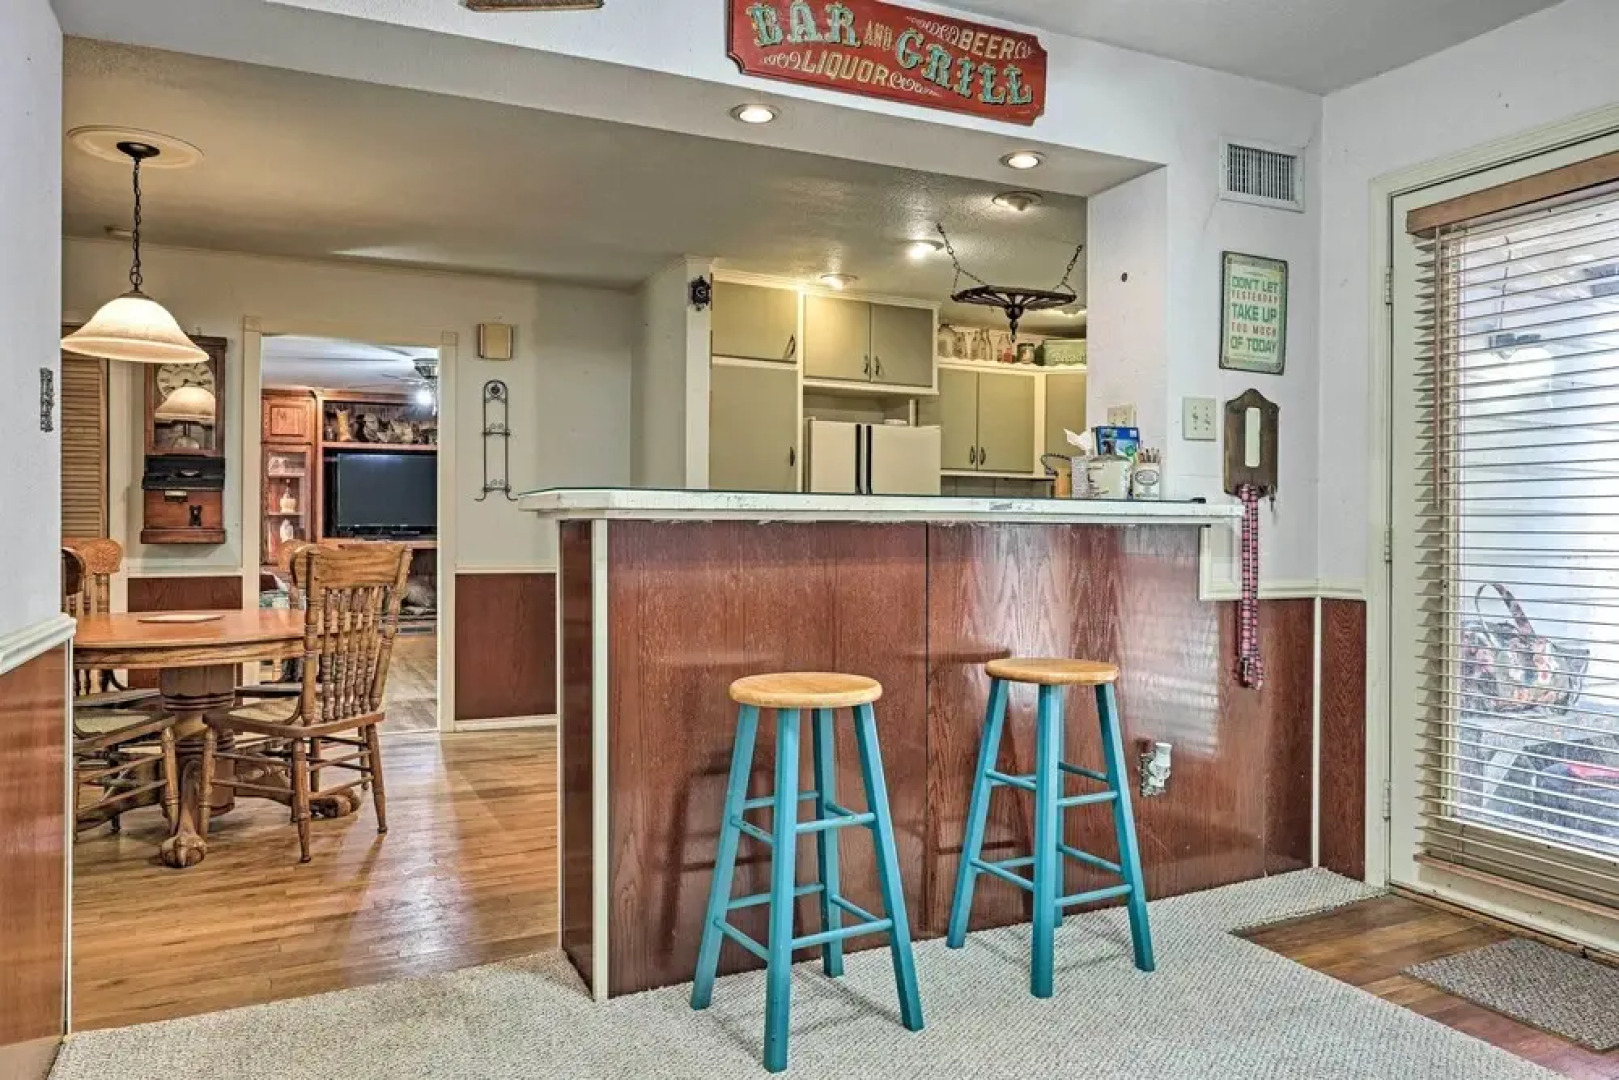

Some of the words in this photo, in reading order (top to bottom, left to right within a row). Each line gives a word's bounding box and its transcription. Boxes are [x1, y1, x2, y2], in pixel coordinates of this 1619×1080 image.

[746, 0, 861, 47] BAR
[864, 20, 893, 51] AND
[896, 27, 1034, 105] GRILL
[958, 28, 1016, 60] BEER
[801, 49, 890, 87] LIQUOR
[1262, 281, 1278, 293] LET
[1231, 303, 1259, 321] TAKE
[1262, 308, 1278, 323] UP
[1230, 336, 1244, 350] OF
[1246, 338, 1276, 354] TODAY
